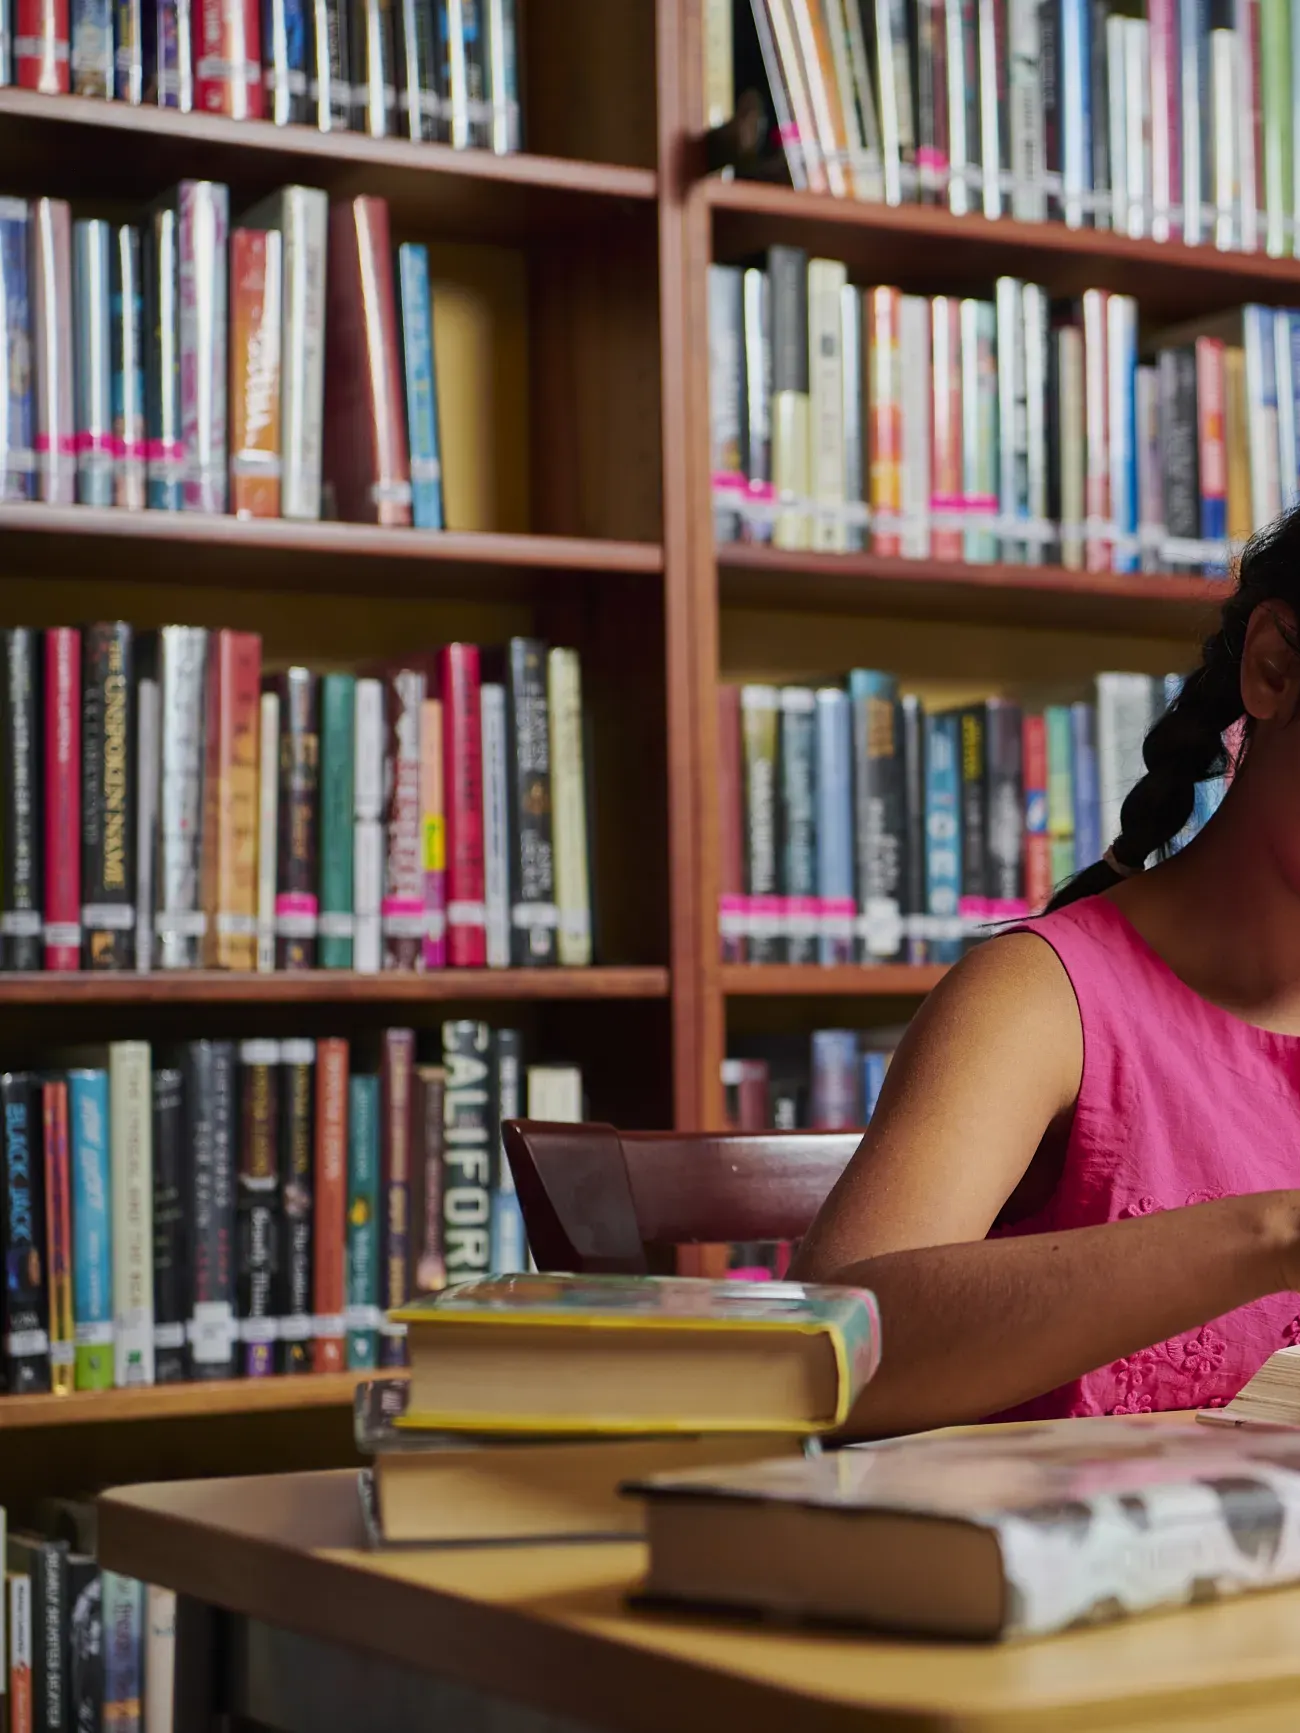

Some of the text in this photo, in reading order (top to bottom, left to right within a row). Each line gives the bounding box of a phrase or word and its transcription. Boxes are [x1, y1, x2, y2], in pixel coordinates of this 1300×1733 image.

[103, 675, 126, 808] UNSPOKEN
[102, 813, 124, 891] NAME
[5, 1102, 32, 1241] BLACK JACK
[214, 1129, 229, 1209] WORDS
[126, 1270, 142, 1308] REA
[248, 1272, 270, 1317] Thing
[44, 1606, 62, 1668] DEVOTED
[45, 1671, 62, 1728] DEXTER
